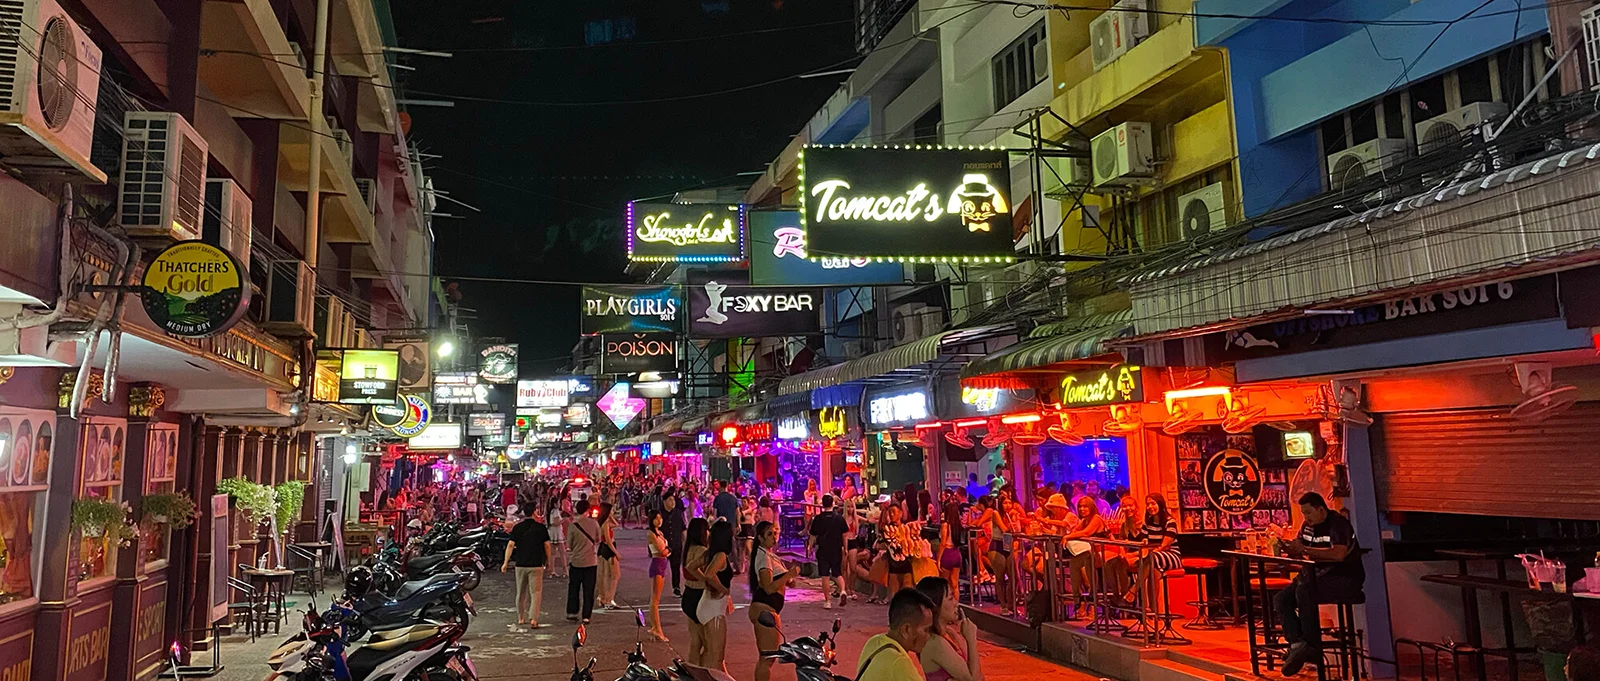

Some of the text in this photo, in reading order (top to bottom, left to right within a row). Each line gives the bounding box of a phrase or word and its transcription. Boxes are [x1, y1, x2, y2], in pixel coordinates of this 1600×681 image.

[811, 179, 943, 222] Tomcat's
[636, 212, 713, 246] Showgirls
[157, 260, 229, 273] THATCHERS
[167, 274, 213, 294] Gold
[586, 296, 677, 316] PLAYGIRLS
[774, 294, 813, 312] BAR
[1385, 295, 1436, 319] BAR
[1443, 285, 1489, 309] SOI
[1497, 281, 1514, 299] 6
[166, 321, 212, 332] MEDIUM DRY
[607, 340, 673, 356] POISON
[519, 388, 567, 398] Ruby Club
[1062, 372, 1115, 405] Tomcat's
[1218, 494, 1254, 508] Tomcat's
[69, 634, 90, 674] RTS
